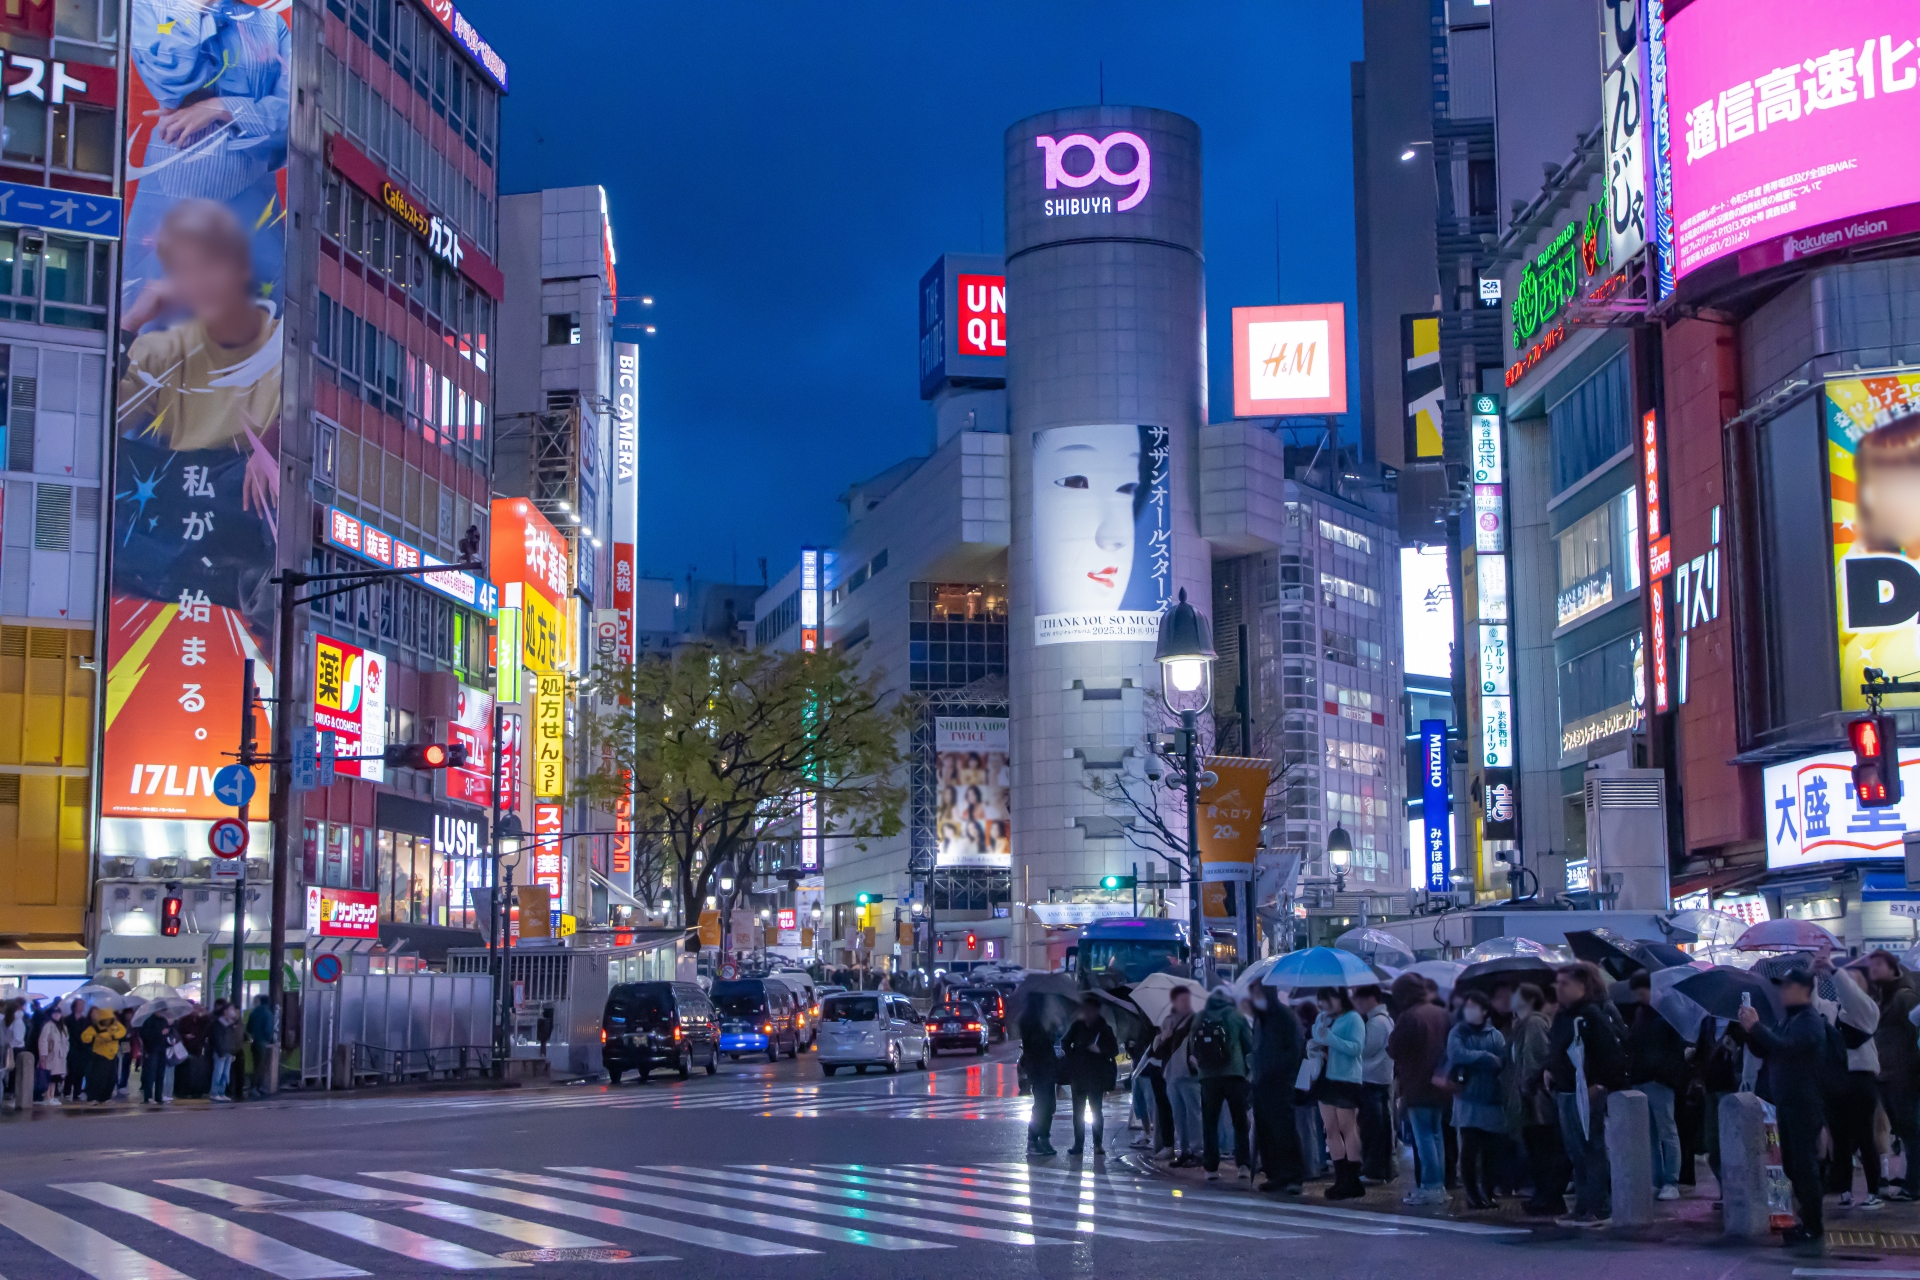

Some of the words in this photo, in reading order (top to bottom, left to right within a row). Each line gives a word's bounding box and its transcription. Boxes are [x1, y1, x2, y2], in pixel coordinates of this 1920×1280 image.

[0, 49, 87, 104] スト
[1685, 33, 1920, 166] 通信高速化
[1036, 131, 1151, 212] 109
[1044, 196, 1111, 217] SHIBUYA
[429, 214, 465, 269] ガスト
[1792, 229, 1843, 252] Rakuten
[1844, 219, 1888, 240] Vision
[619, 354, 634, 389] BIC
[1262, 341, 1317, 378] H&M
[618, 392, 634, 480] CAMERA
[1478, 418, 1496, 469] 渋谷西村
[1481, 487, 1495, 496] 4F
[1148, 426, 1173, 614] サザンオールスターズ
[366, 528, 390, 563] 抜毛
[804, 551, 815, 565] THE
[616, 559, 631, 592] 免税
[804, 566, 815, 588] PRIME
[479, 583, 497, 613] 4F
[1082, 615, 1106, 625] YOU
[1109, 615, 1125, 625] SO
[1483, 645, 1494, 679] パーラー
[1494, 639, 1505, 674] フルーツ
[319, 650, 340, 703] 薬
[315, 711, 331, 727] DRUG
[331, 716, 336, 728] &
[335, 718, 361, 735] COSMETIC
[540, 677, 561, 761] 処方せん
[939, 721, 1006, 731] SHIBUYA109
[950, 732, 986, 741] TWICE
[1486, 717, 1496, 752] フルーツ
[1498, 711, 1508, 748] 渋谷西村
[302, 731, 313, 786] 渋谷駅前
[1430, 734, 1442, 788] MIZUHO
[465, 777, 475, 796] 3F
[543, 764, 555, 793] 3F
[1206, 805, 1252, 820] 食べログ
[1491, 783, 1513, 821] HUB
[434, 814, 478, 858] LUSH
[537, 807, 561, 896] スギ薬局
[1430, 827, 1443, 885] みずほ銀行
[338, 902, 378, 924] サンドラッグ
[780, 910, 794, 919] UNI
[780, 919, 795, 929] QLO
[103, 957, 149, 965] SHIBUYA
[155, 957, 197, 965] EKIMAE
